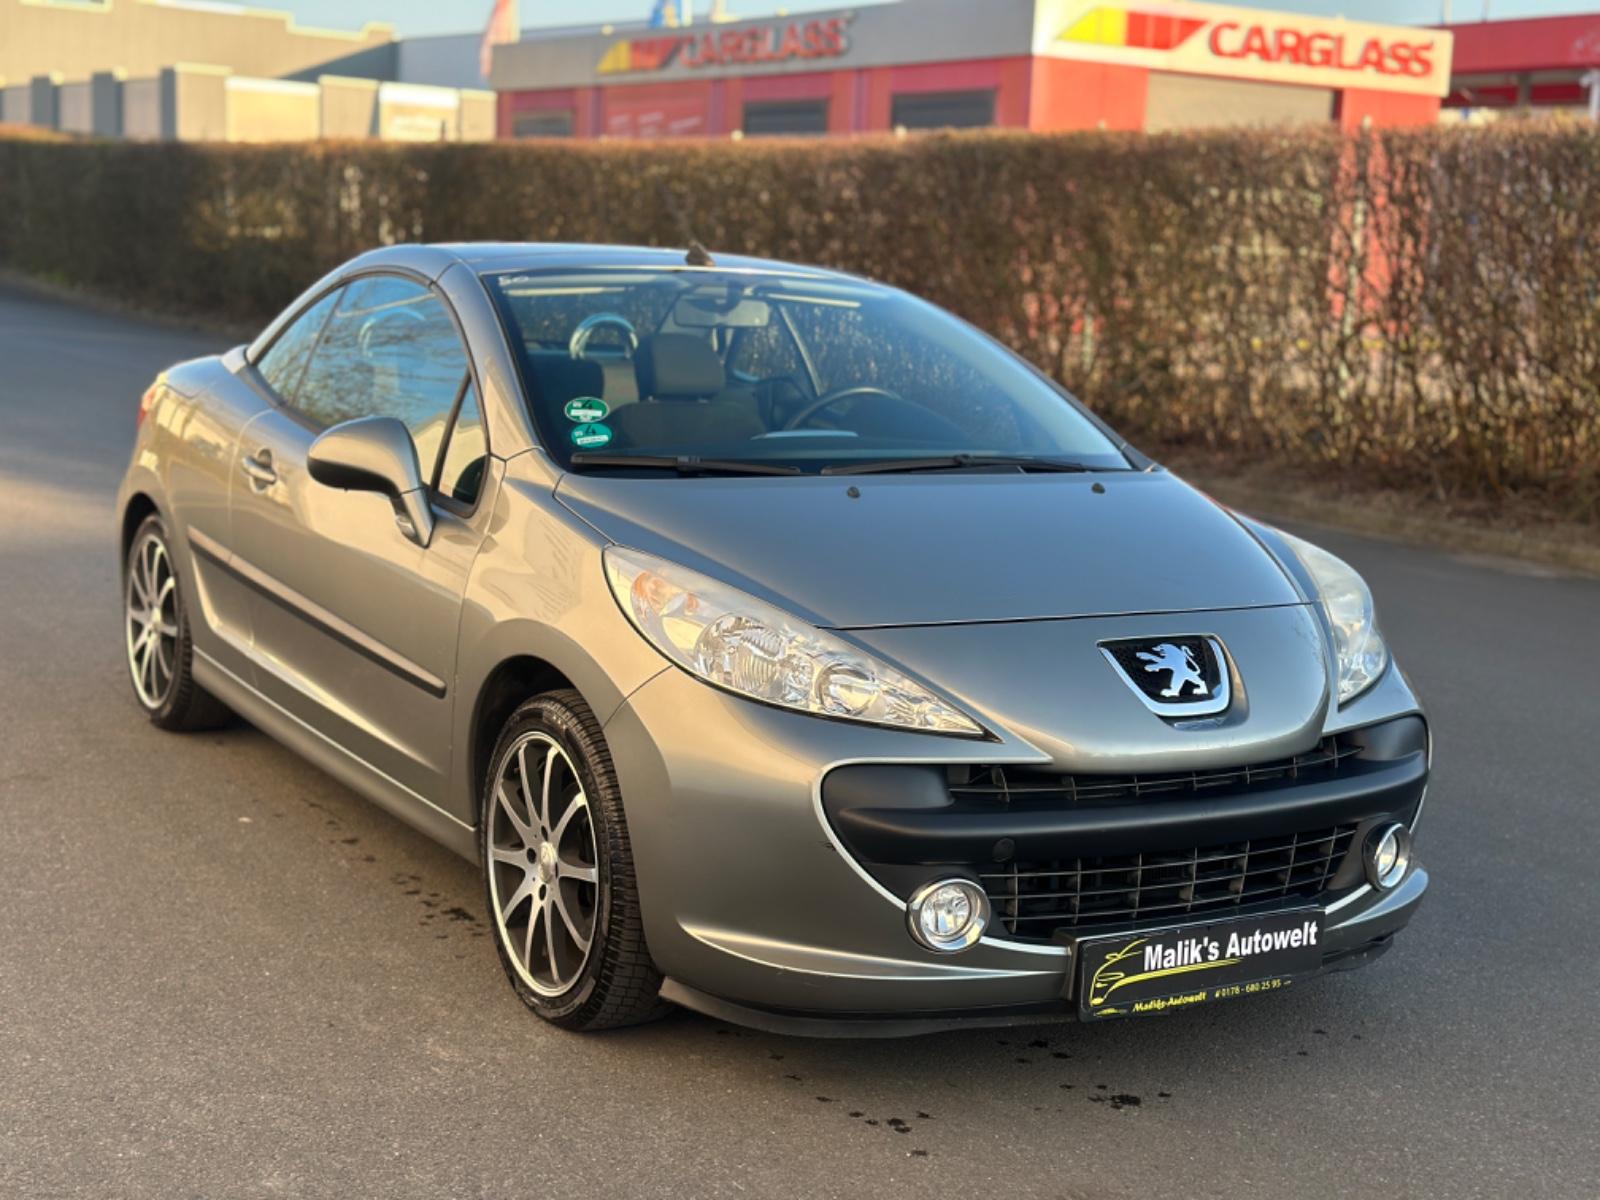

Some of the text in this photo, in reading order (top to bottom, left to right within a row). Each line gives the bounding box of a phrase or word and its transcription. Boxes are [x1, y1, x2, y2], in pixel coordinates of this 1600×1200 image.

[679, 18, 849, 69] CARGLASS
[1208, 22, 1434, 78] CARGLASS
[1143, 920, 1319, 972] Malik's Autowelt
